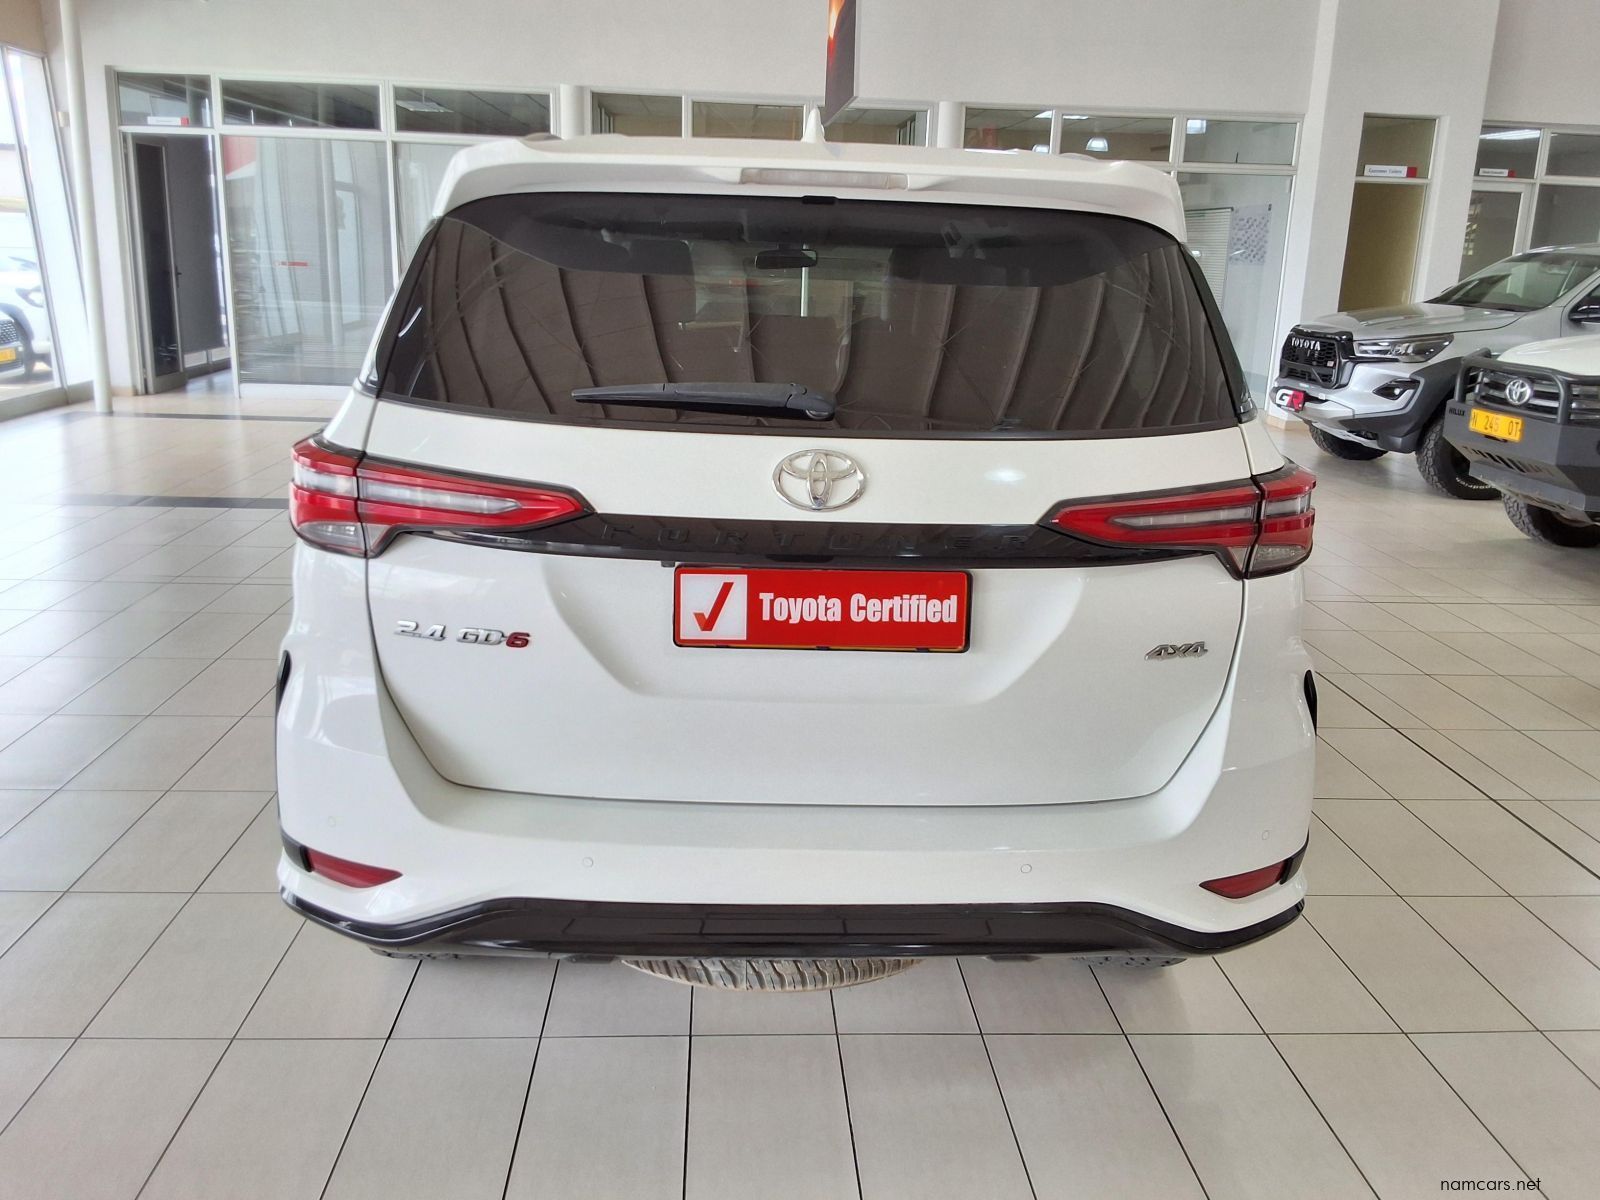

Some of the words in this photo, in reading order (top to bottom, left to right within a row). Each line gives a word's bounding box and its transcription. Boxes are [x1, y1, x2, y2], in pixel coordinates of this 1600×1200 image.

[1292, 337, 1321, 351] TOYOTA
[1275, 388, 1305, 412] GR
[1471, 411, 1479, 428] N
[602, 523, 1027, 550] FORTUNER
[758, 592, 842, 624] Toyota
[850, 593, 958, 623] Certified
[393, 620, 446, 641] 2.4
